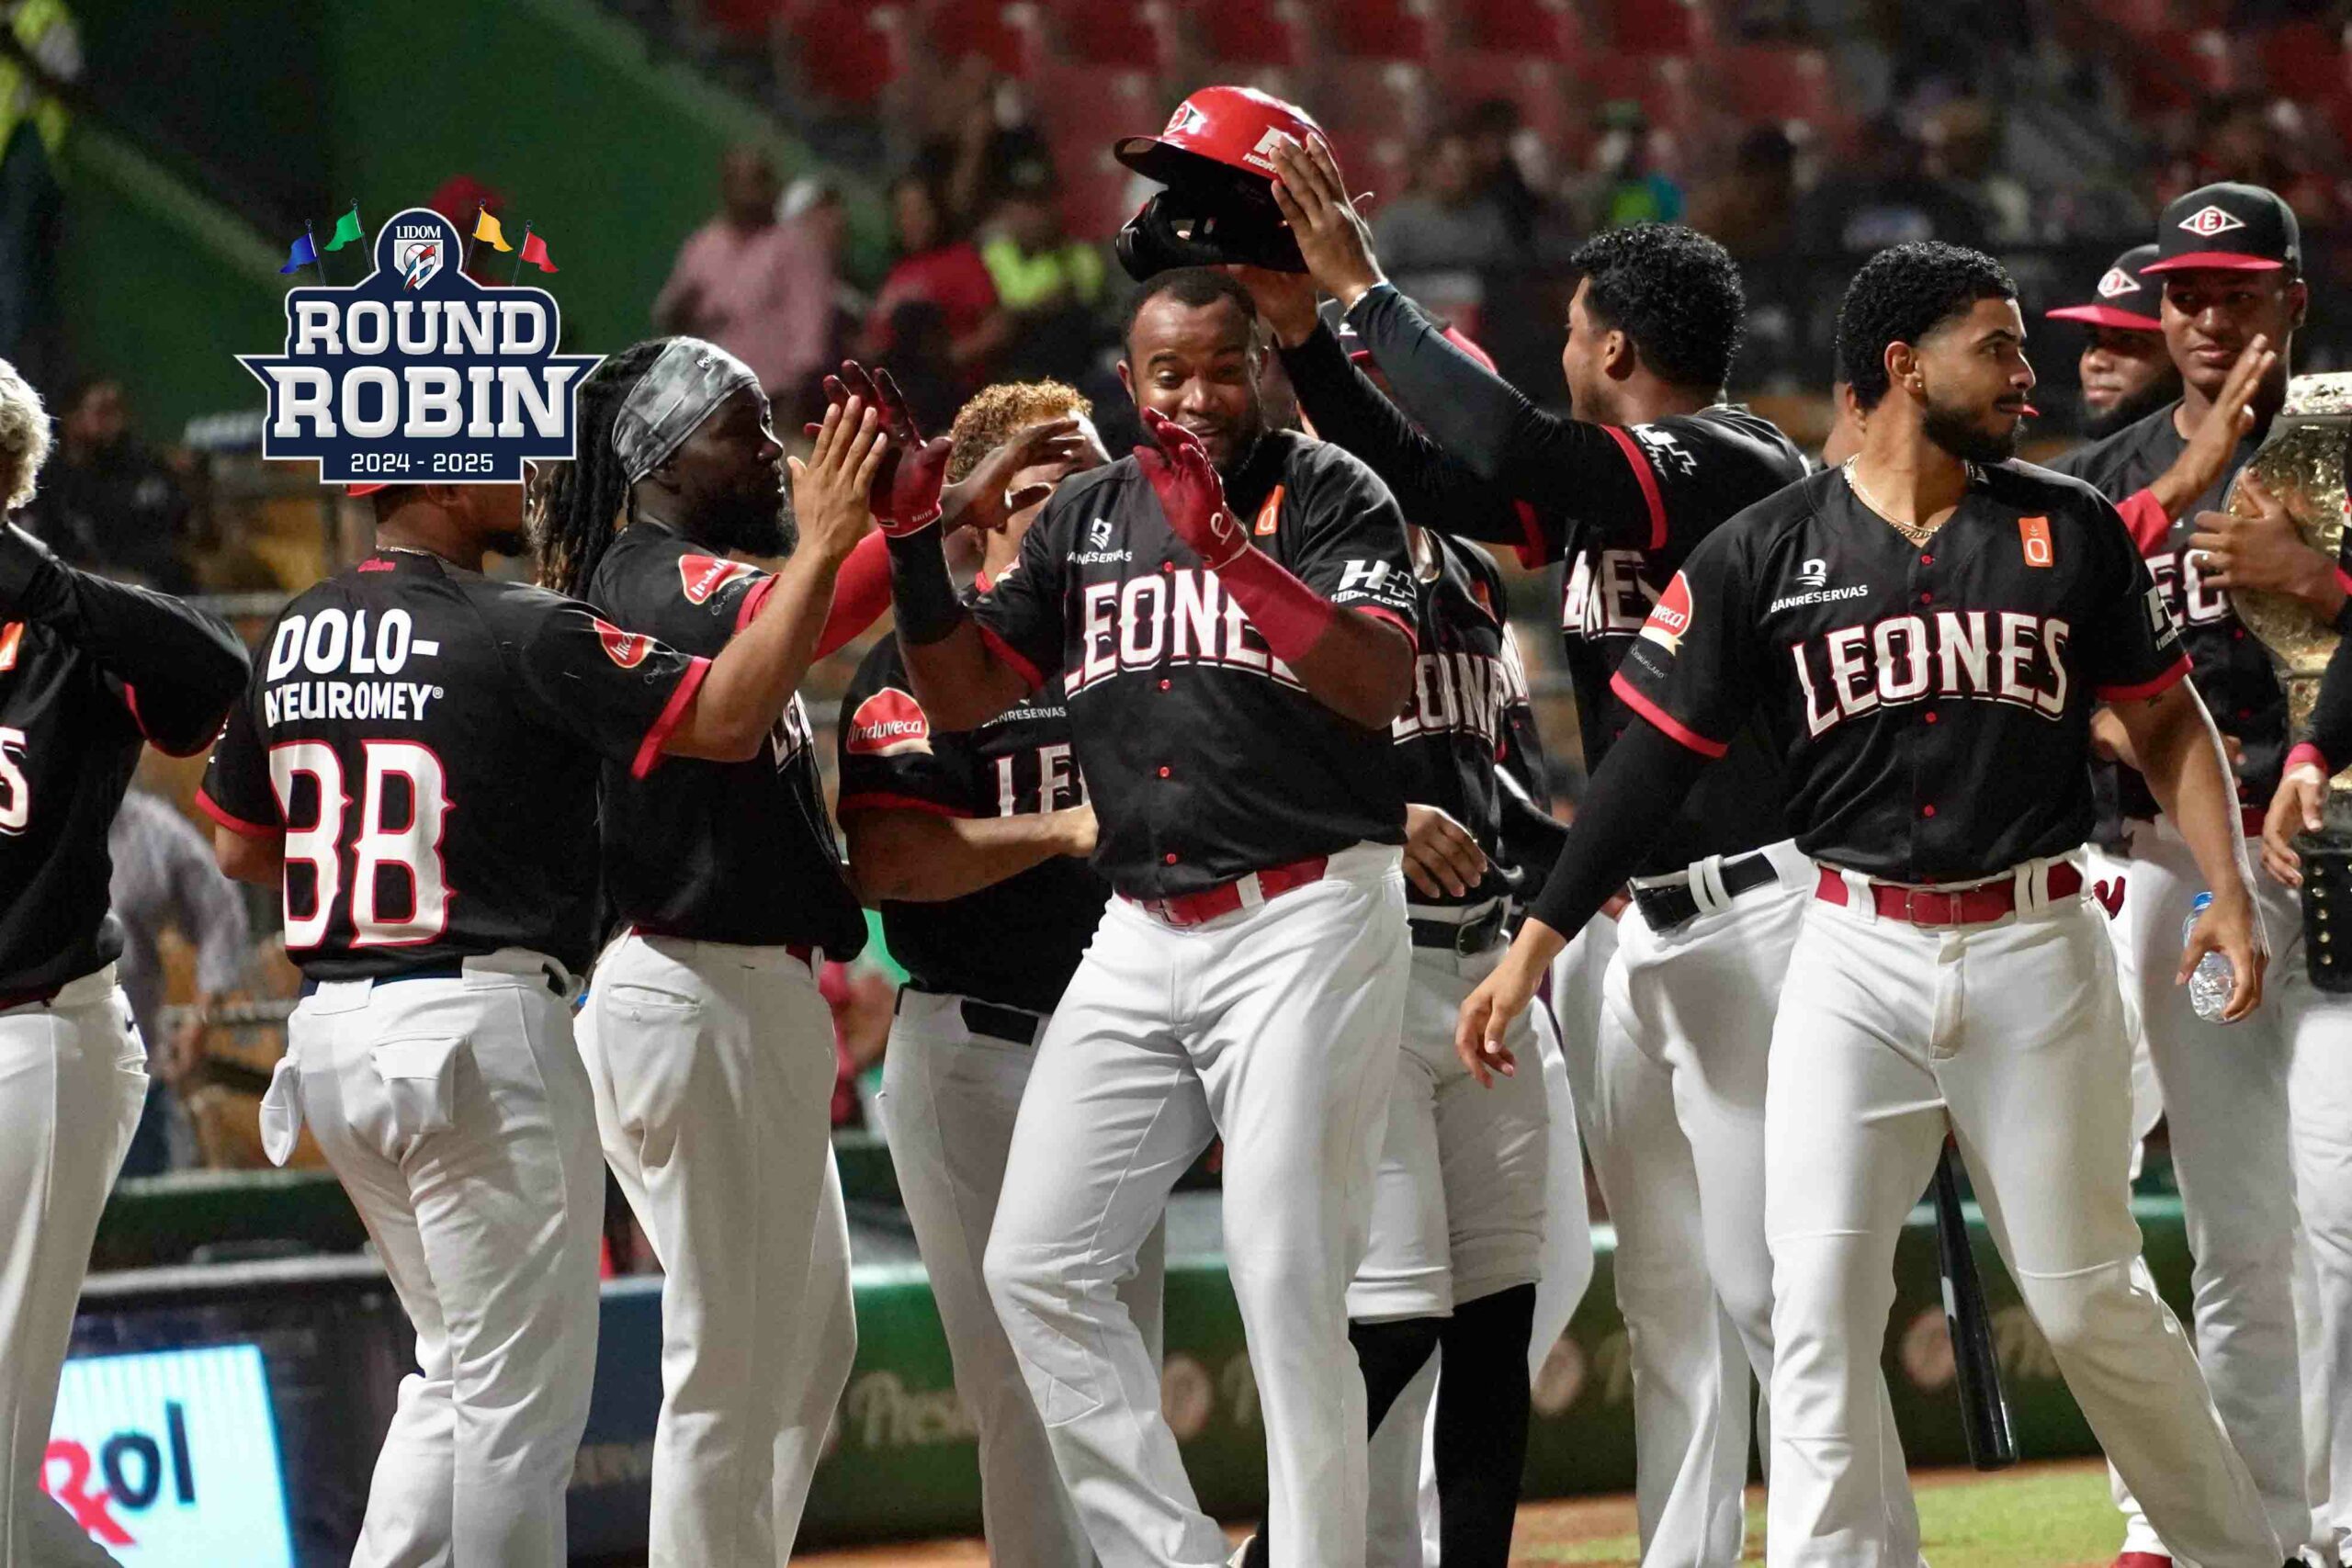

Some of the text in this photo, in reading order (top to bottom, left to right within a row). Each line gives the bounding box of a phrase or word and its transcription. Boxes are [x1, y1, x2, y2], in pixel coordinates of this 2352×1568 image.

[2027, 538, 2050, 563] Q
[1770, 584, 1869, 614] BANRESERVAS
[266, 607, 440, 682] DOLO-
[1792, 610, 2071, 739] LEONES
